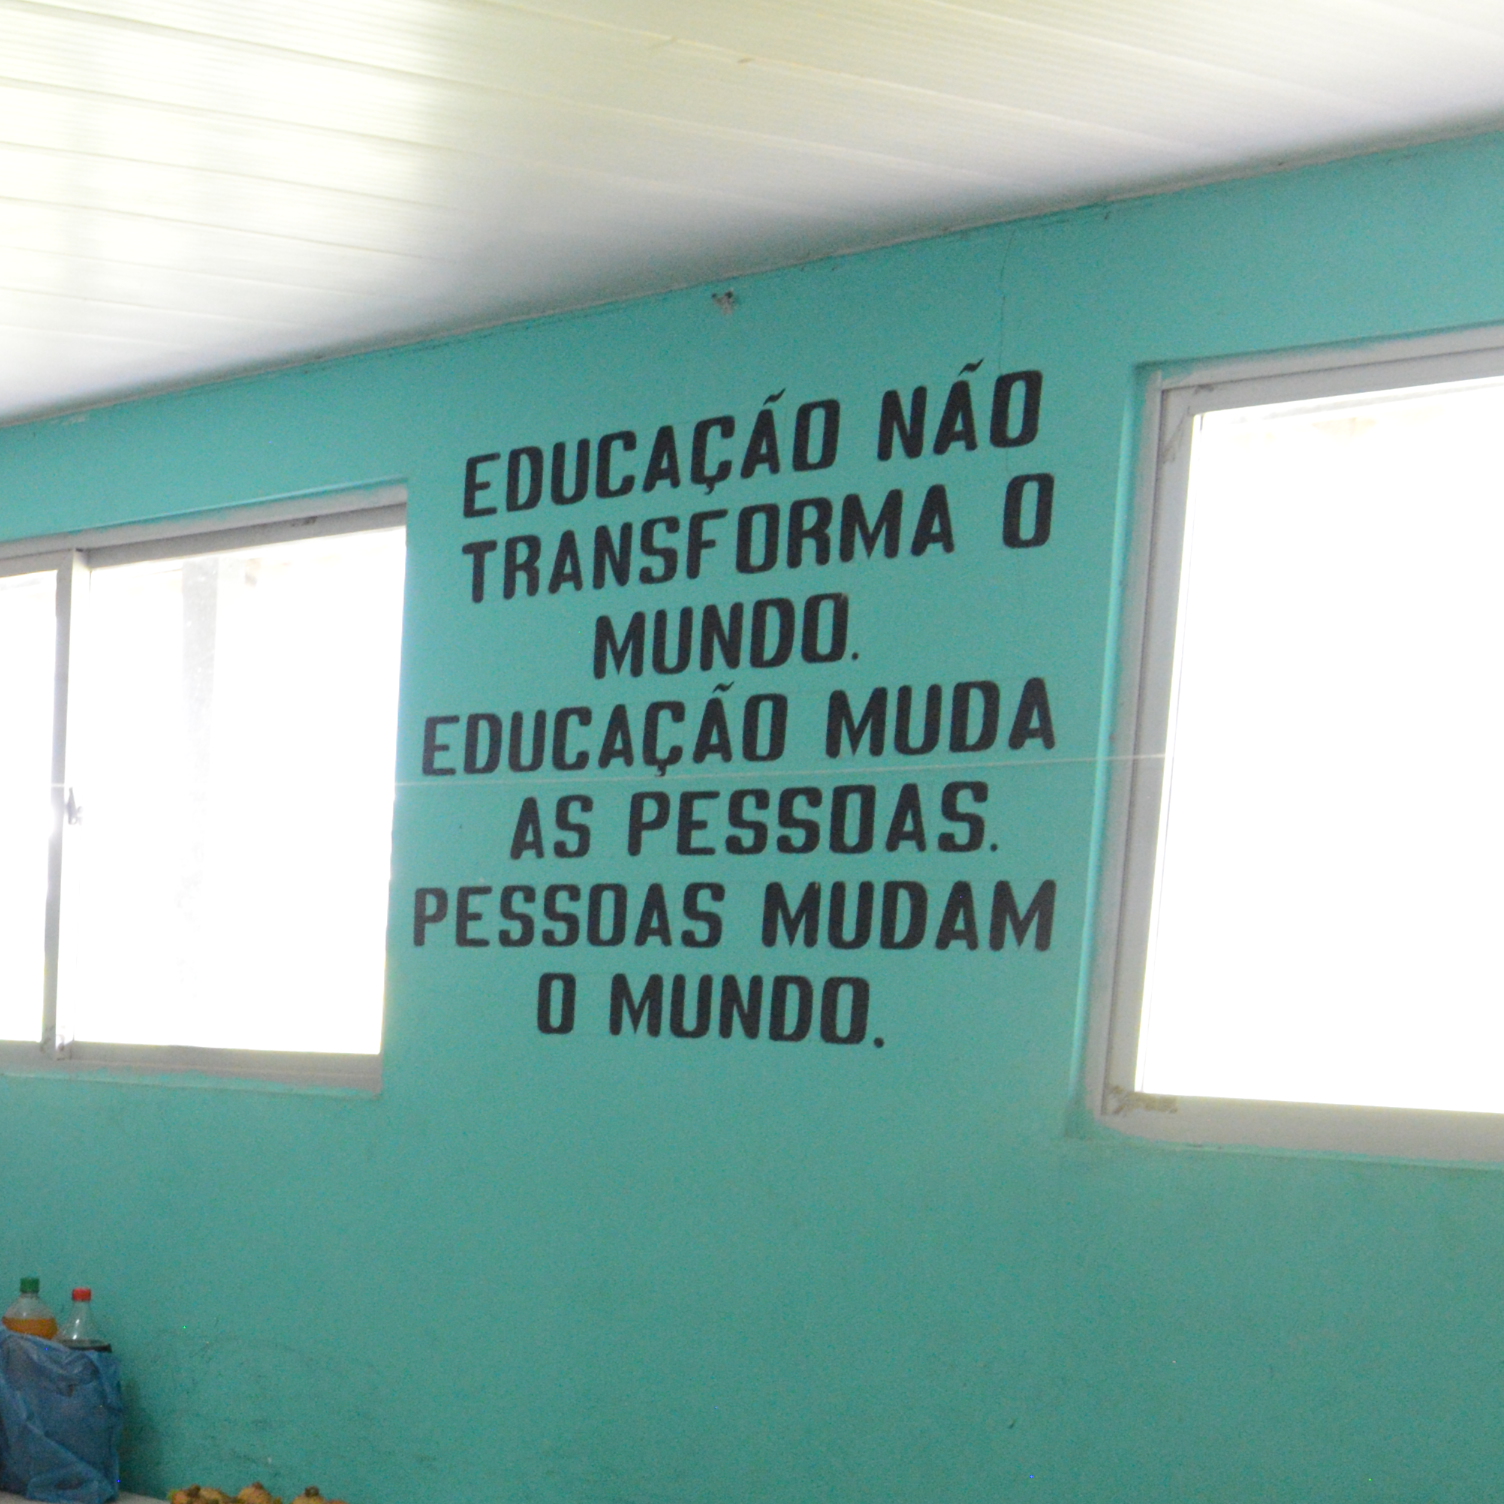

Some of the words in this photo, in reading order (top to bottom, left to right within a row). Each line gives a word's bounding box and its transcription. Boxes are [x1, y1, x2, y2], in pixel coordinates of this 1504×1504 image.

[462, 386, 842, 520] EDUCAÇÃO
[875, 356, 1045, 463] NÃO
[460, 482, 956, 605] TRANSFORMA
[1001, 471, 1056, 550] O
[592, 591, 861, 681] MUNDO.
[422, 679, 790, 778] EDUCAÇÃO
[824, 675, 1058, 760] MUDA
[509, 793, 595, 861] AS
[626, 779, 1000, 859] PESSOAS.
[413, 880, 727, 950] PESSOAS
[760, 878, 1058, 953] MUDAM
[535, 971, 578, 1037] O
[608, 970, 887, 1051] MUNDO.
